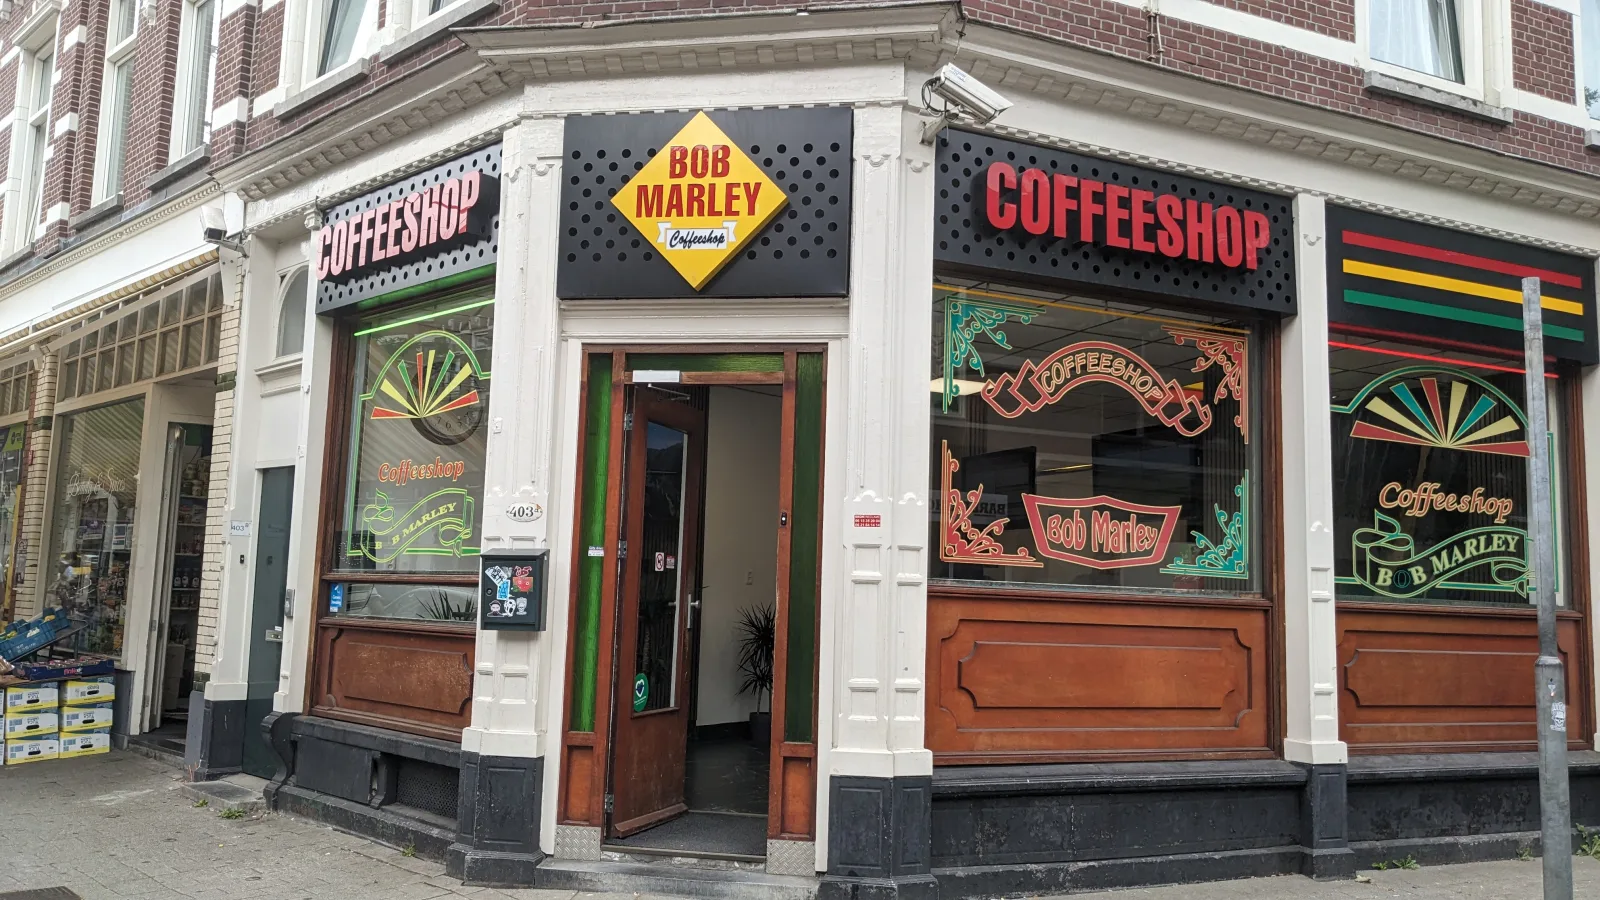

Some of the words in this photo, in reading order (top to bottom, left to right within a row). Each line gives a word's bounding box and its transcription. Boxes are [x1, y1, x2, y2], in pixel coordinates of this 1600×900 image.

[669, 144, 731, 179] BOB
[636, 182, 762, 218] MARLEY
[986, 161, 1271, 270] COFFEESHOP
[316, 170, 481, 281] COFFEESHOP
[669, 230, 725, 249] Coffeeshop
[1040, 352, 1164, 401] COFFEESHOP
[378, 456, 464, 487] Coffeeshop
[402, 502, 456, 537] MARLEY
[1379, 481, 1513, 524] Coffeeshop
[1047, 509, 1086, 550] Bob
[1092, 510, 1158, 553] Marley
[1375, 565, 1427, 588] BOB
[1429, 533, 1519, 575] MARLEY
